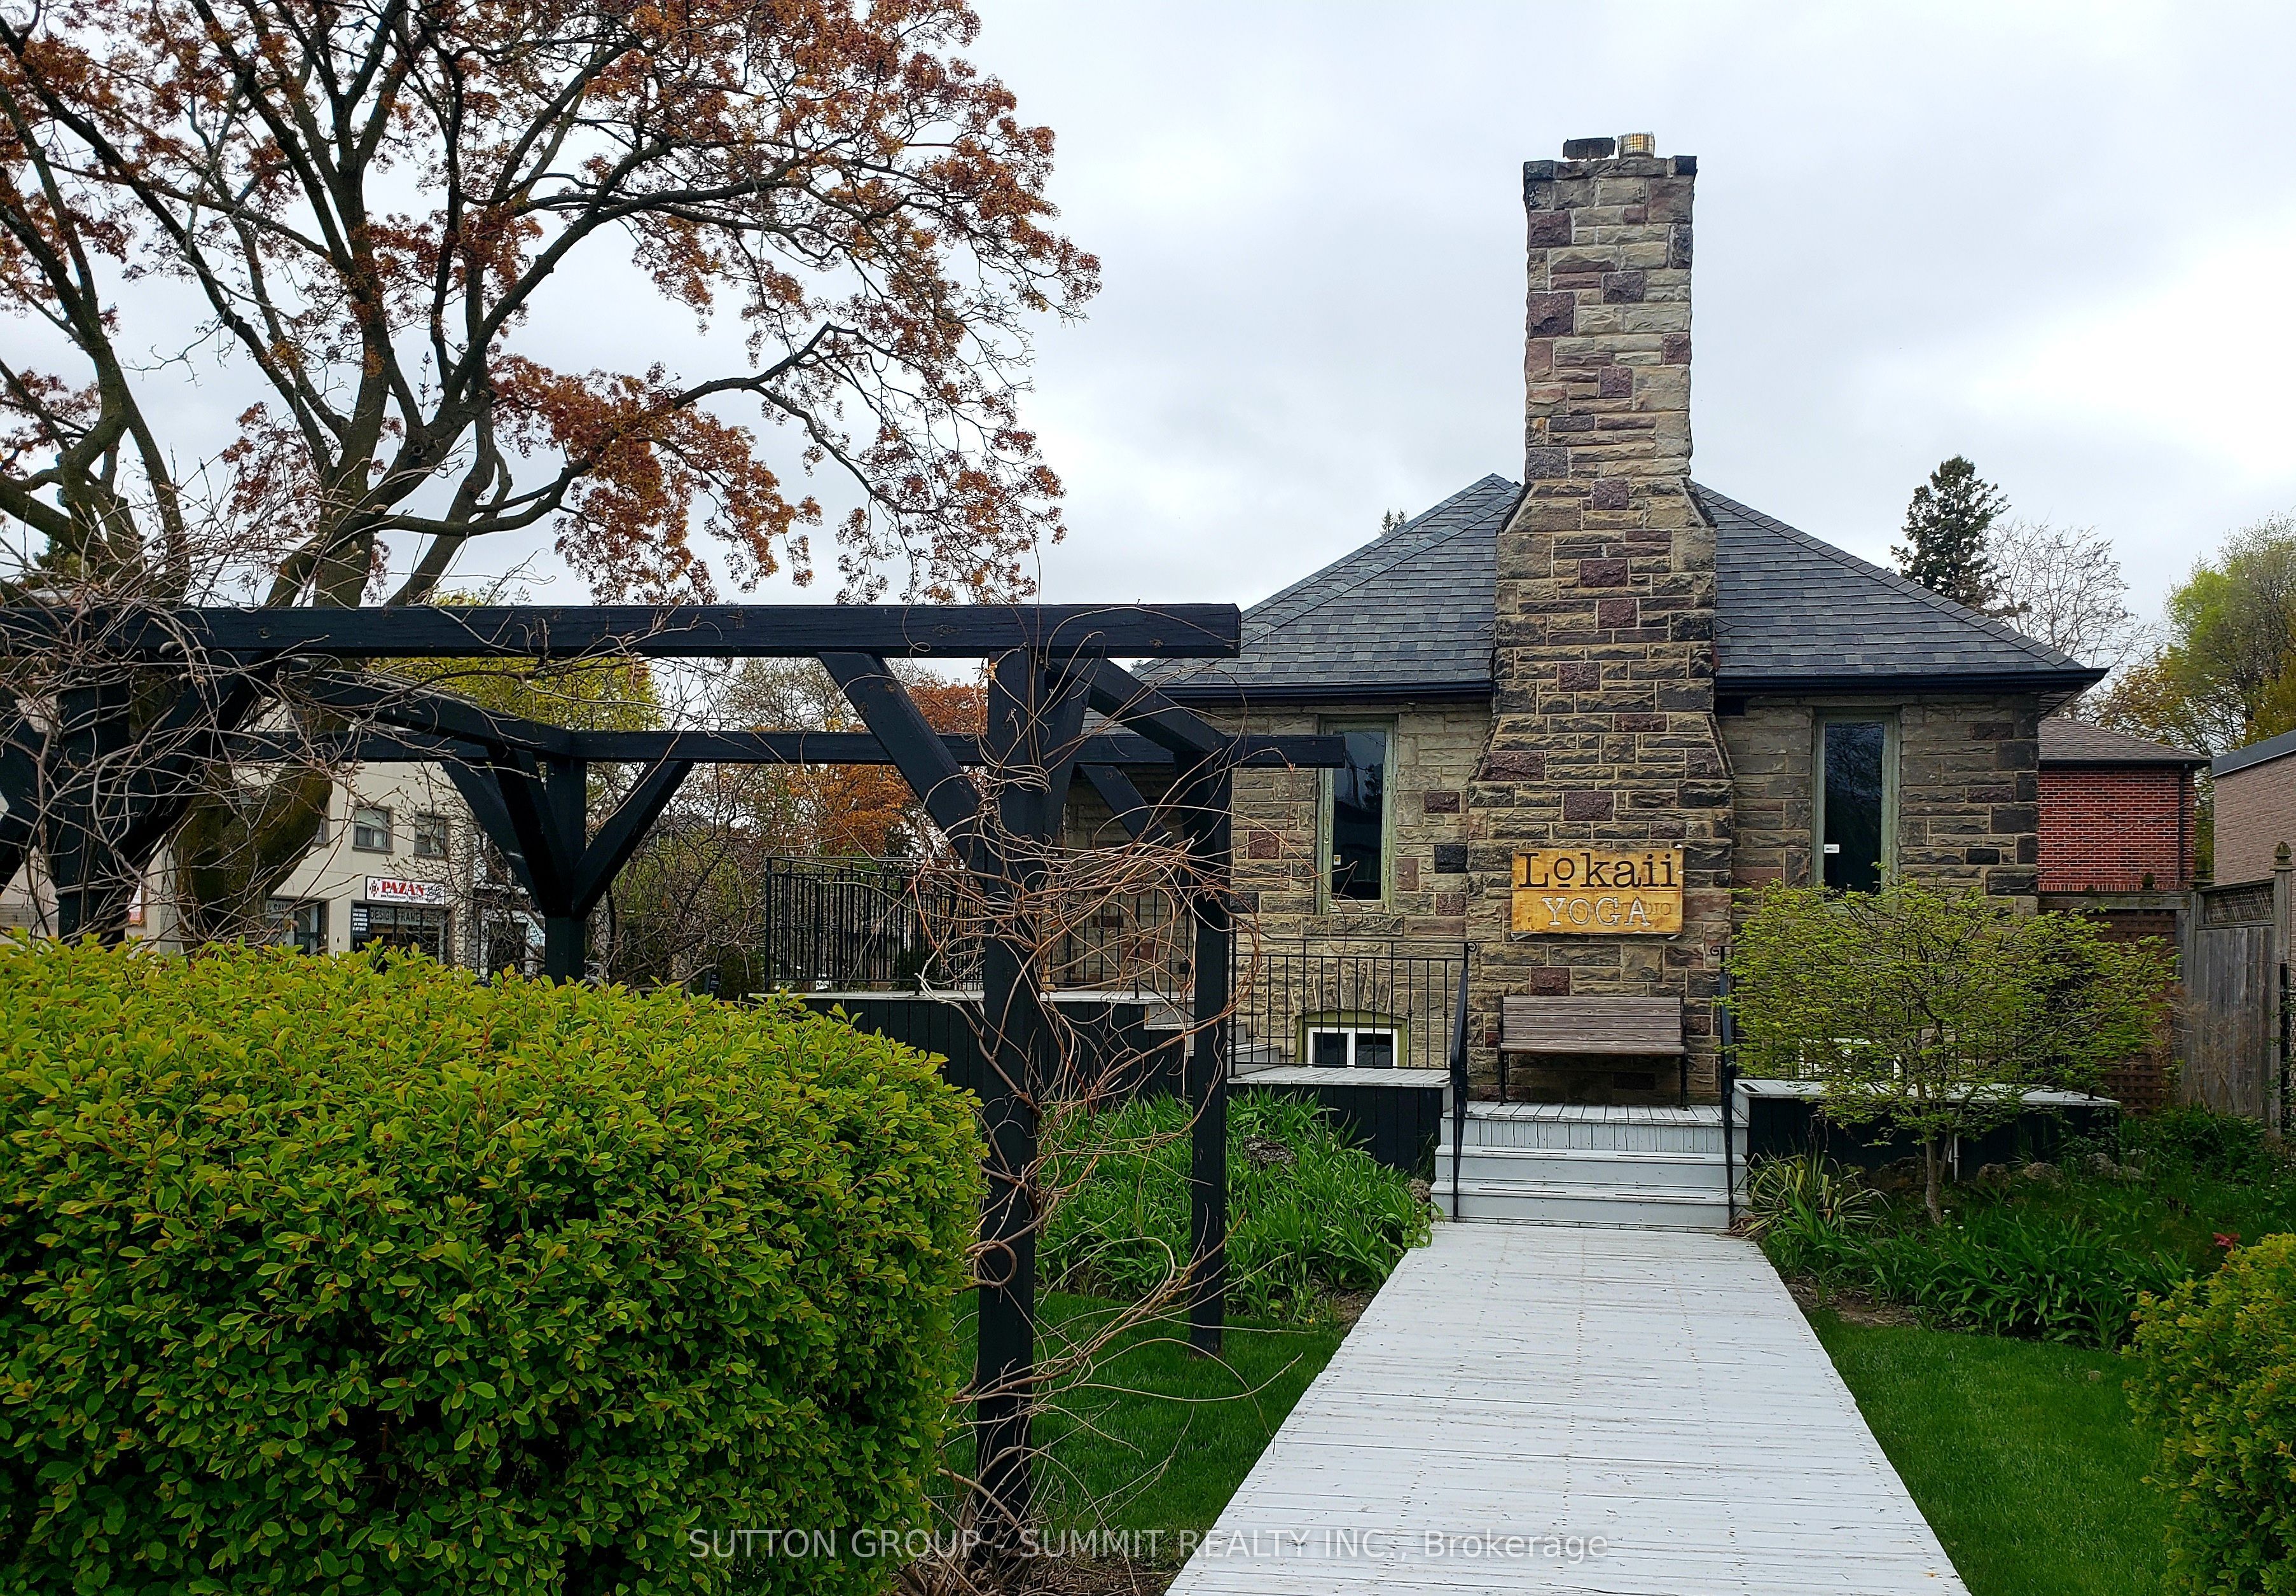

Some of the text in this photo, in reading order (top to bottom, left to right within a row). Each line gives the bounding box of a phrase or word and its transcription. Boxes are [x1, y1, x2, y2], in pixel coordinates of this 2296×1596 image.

[1518, 853, 1678, 888] Lokaii
[381, 881, 425, 896] PAZAN
[370, 910, 394, 921] DESIGN
[1540, 897, 1652, 926] YOGA
